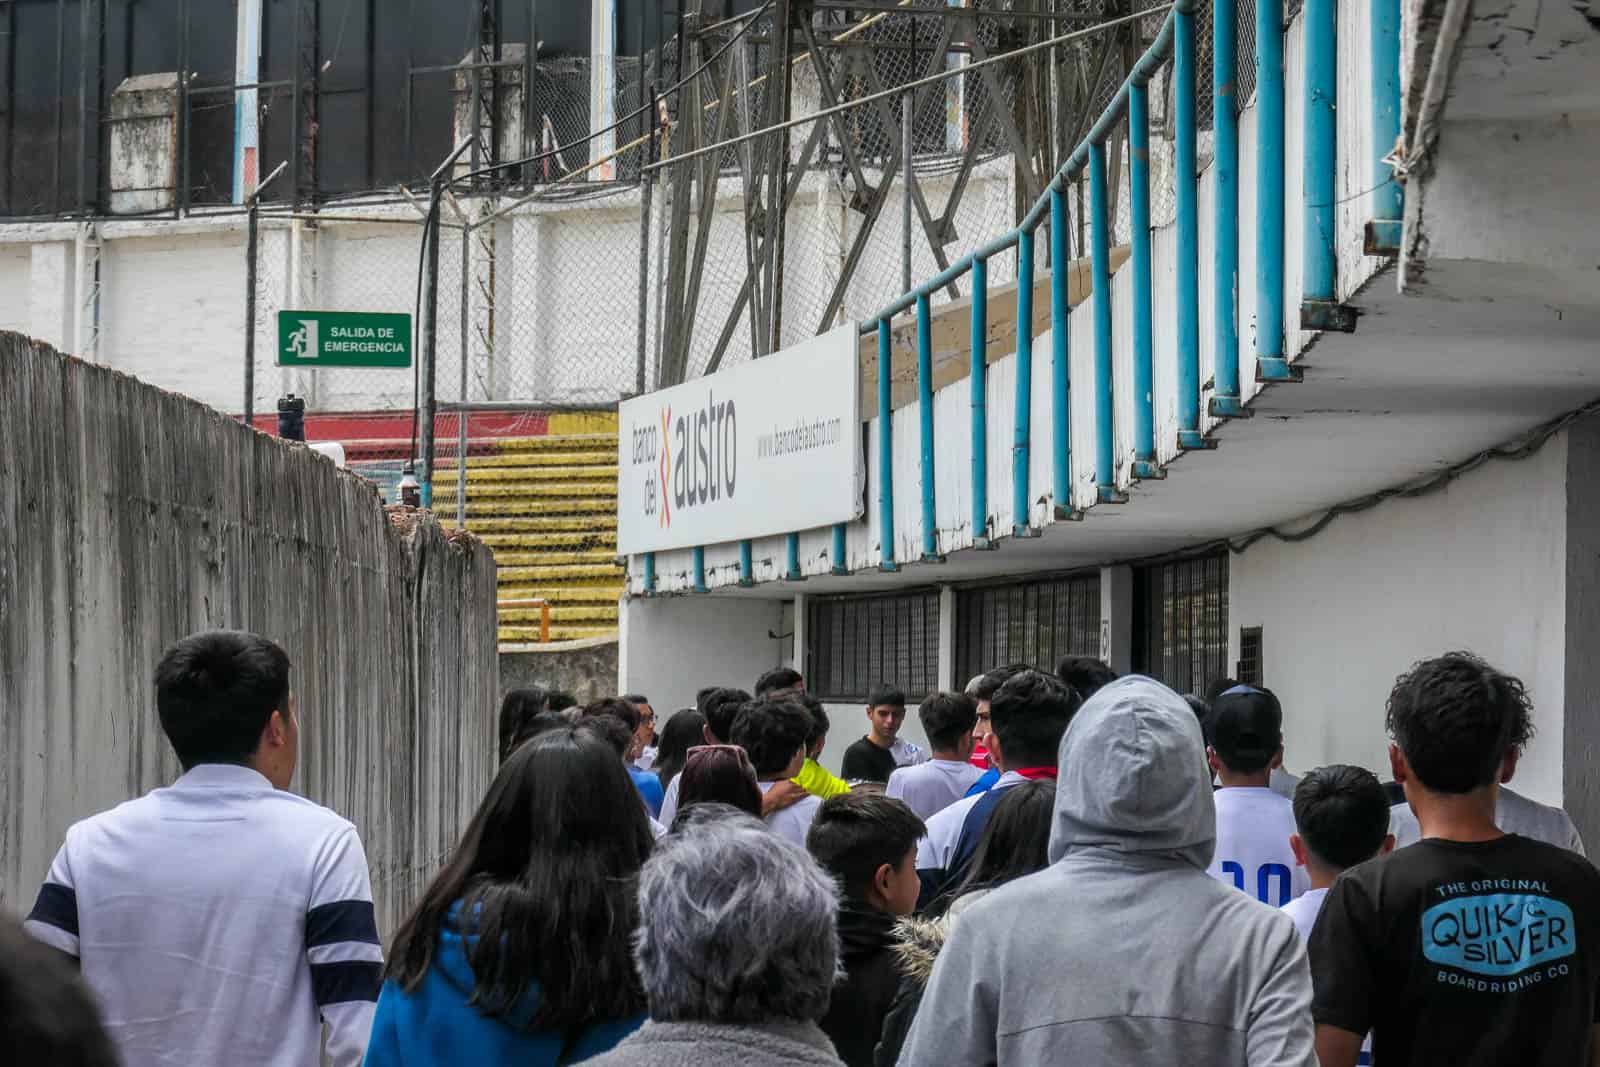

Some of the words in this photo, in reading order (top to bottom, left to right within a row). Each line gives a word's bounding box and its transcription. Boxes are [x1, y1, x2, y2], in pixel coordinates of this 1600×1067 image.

[324, 341, 405, 353] EMERGENCIA
[331, 327, 375, 338] SALIDA
[377, 328, 394, 338] DE
[632, 422, 657, 464] banco
[674, 388, 737, 510] austro
[644, 469, 657, 516] del
[1437, 882, 1466, 896] THE
[1471, 879, 1550, 893] ORIGINAL
[1431, 903, 1519, 946] QUIK
[1463, 916, 1568, 964] SILVER
[1547, 963, 1569, 979] CO
